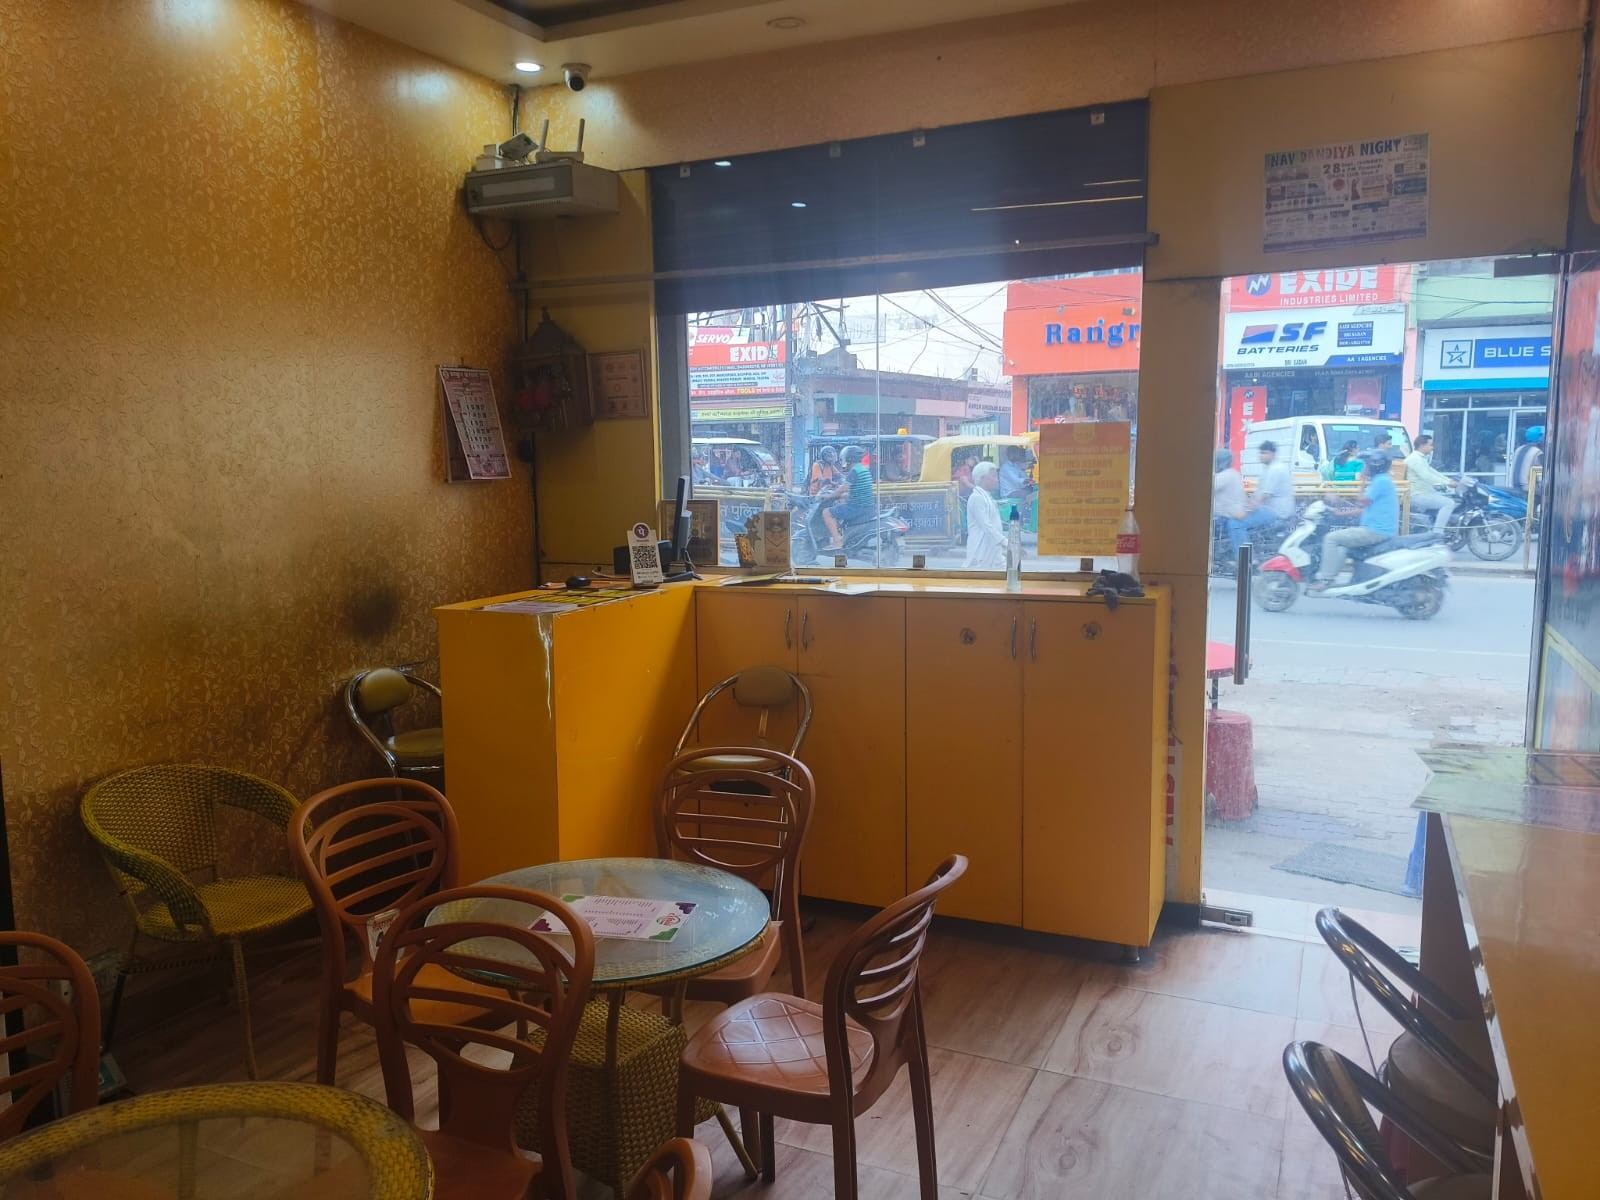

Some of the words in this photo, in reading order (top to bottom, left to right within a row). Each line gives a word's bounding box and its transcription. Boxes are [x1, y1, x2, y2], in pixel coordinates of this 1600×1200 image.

[1270, 154, 1296, 168] NAV
[1360, 139, 1402, 156] NIGHT
[1279, 266, 1378, 295] EXIDE
[1279, 295, 1337, 306] INDUSTRIES
[1339, 293, 1378, 304] LIMITED
[696, 334, 730, 344] SERVO
[1045, 318, 1140, 348] Rangr
[1279, 321, 1328, 342] SF
[1237, 345, 1319, 355] BATTERIES
[1484, 346, 1535, 358] BLUE
